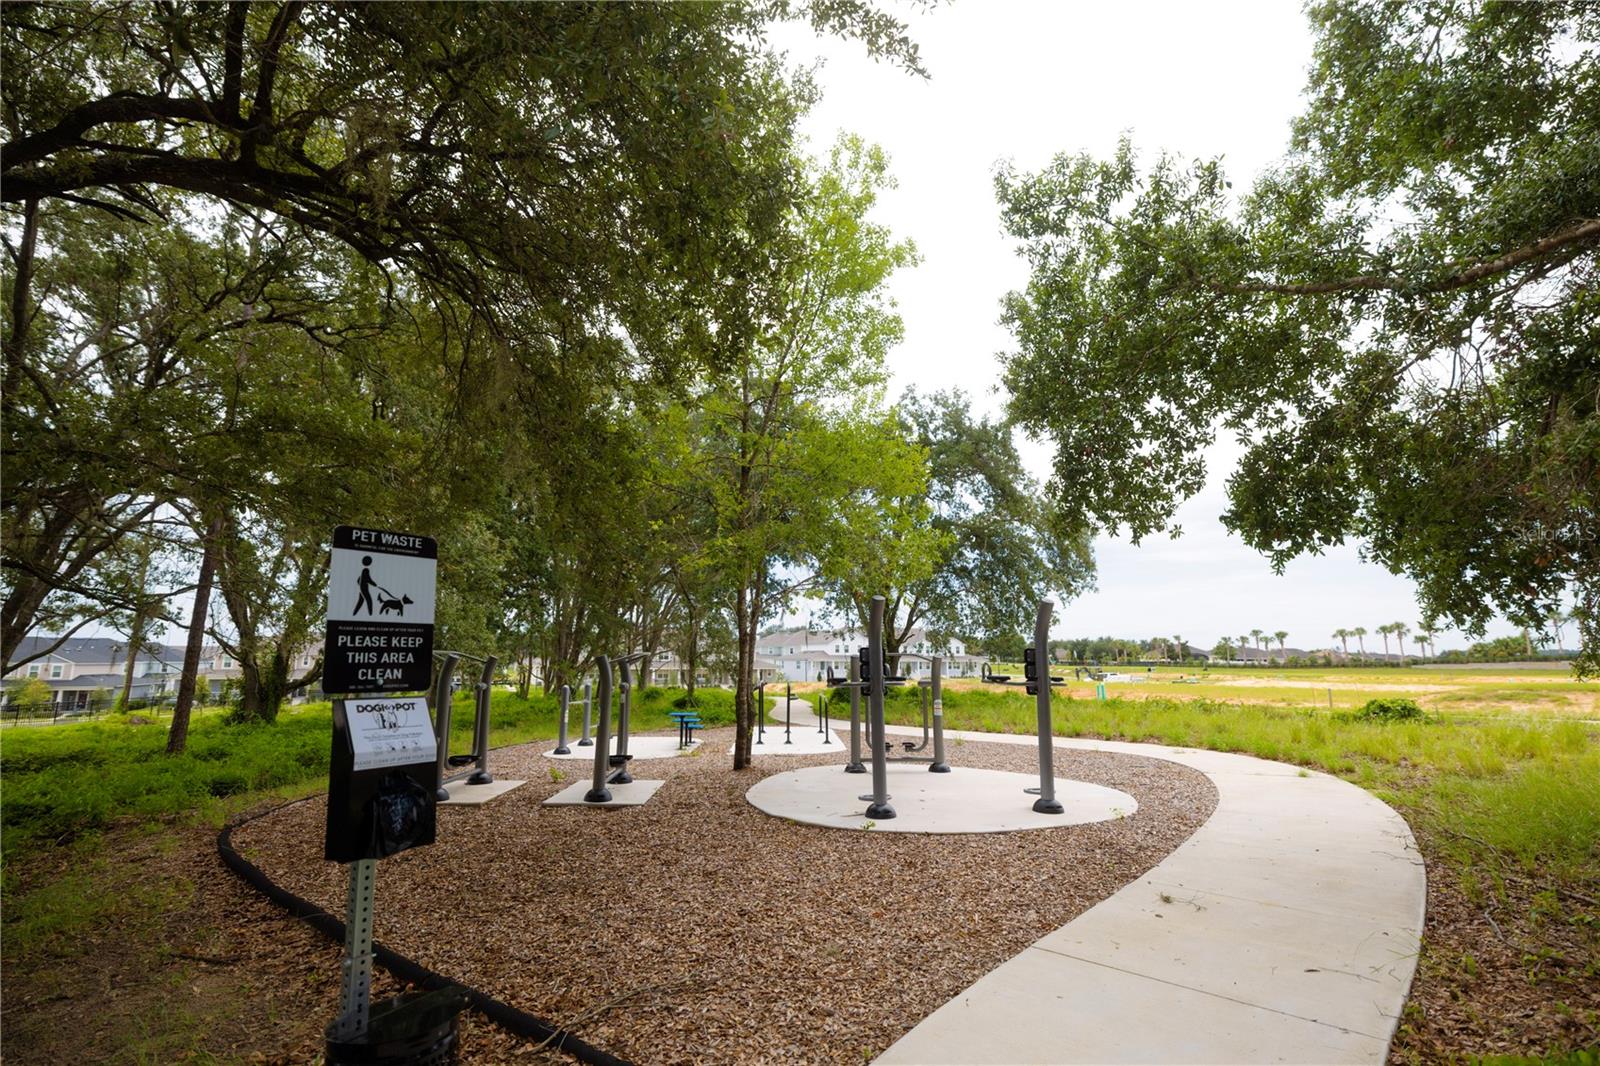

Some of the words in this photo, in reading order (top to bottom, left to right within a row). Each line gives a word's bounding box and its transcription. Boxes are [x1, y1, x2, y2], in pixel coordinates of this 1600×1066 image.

[352, 529, 377, 543] PET
[381, 533, 423, 549] WASTE
[337, 635, 388, 647] PLEASE
[391, 636, 424, 648] KEEP
[347, 651, 378, 664] THIS
[380, 652, 415, 664] AREA
[358, 668, 403, 680] CLEAN
